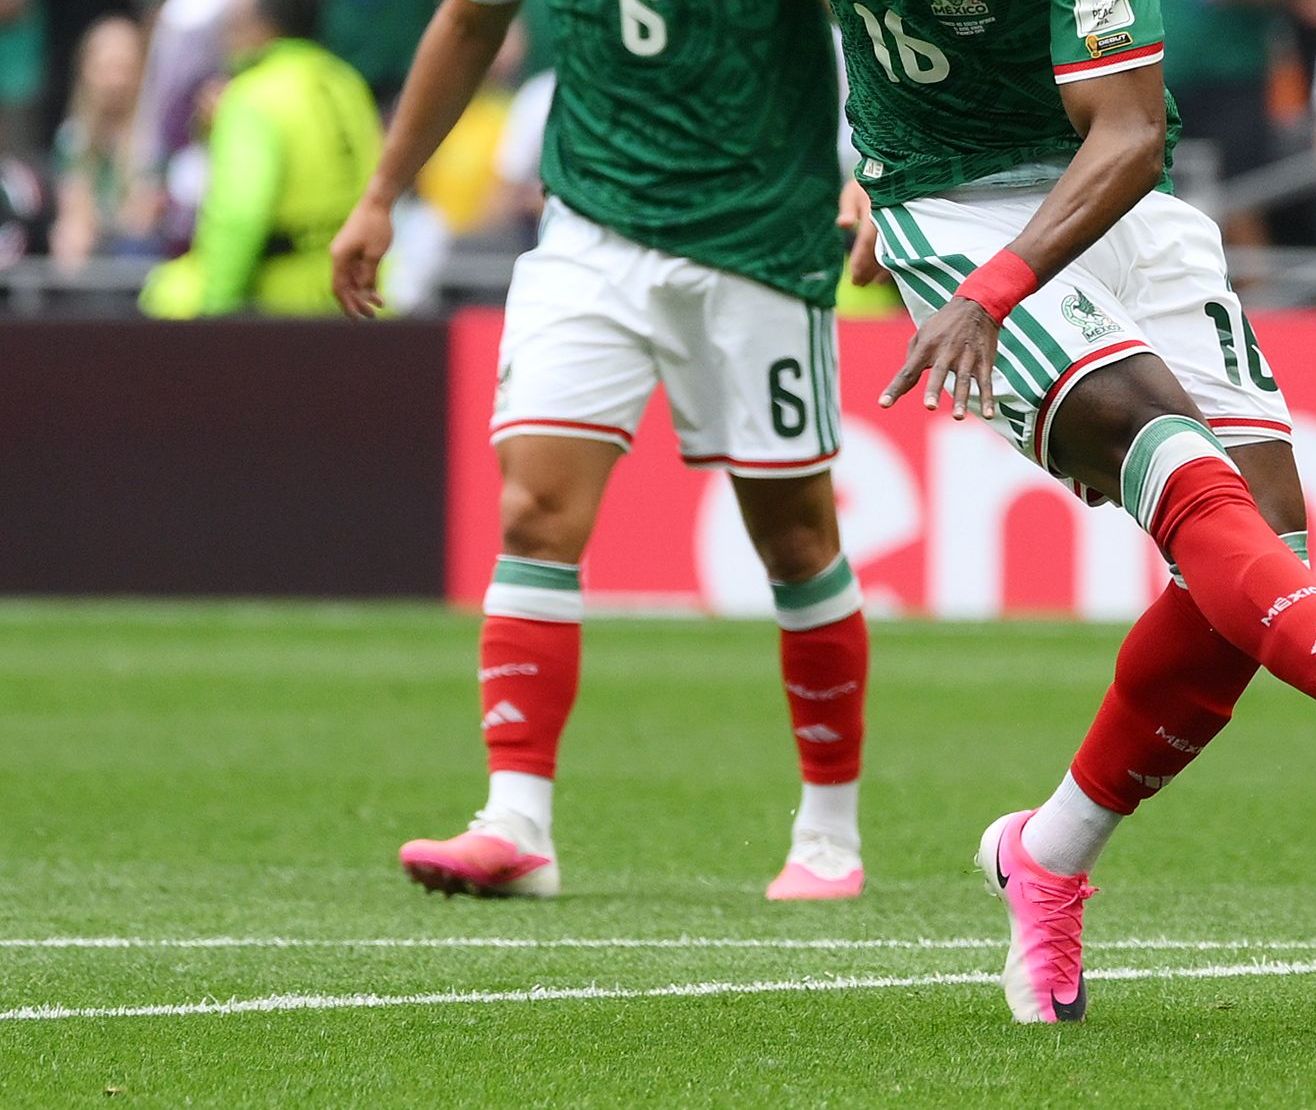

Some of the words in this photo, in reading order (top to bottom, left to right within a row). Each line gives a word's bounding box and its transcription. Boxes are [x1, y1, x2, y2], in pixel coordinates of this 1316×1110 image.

[853, 3, 950, 84] 16
[1099, 35, 1126, 45] DEBUT
[769, 357, 806, 439] 6
